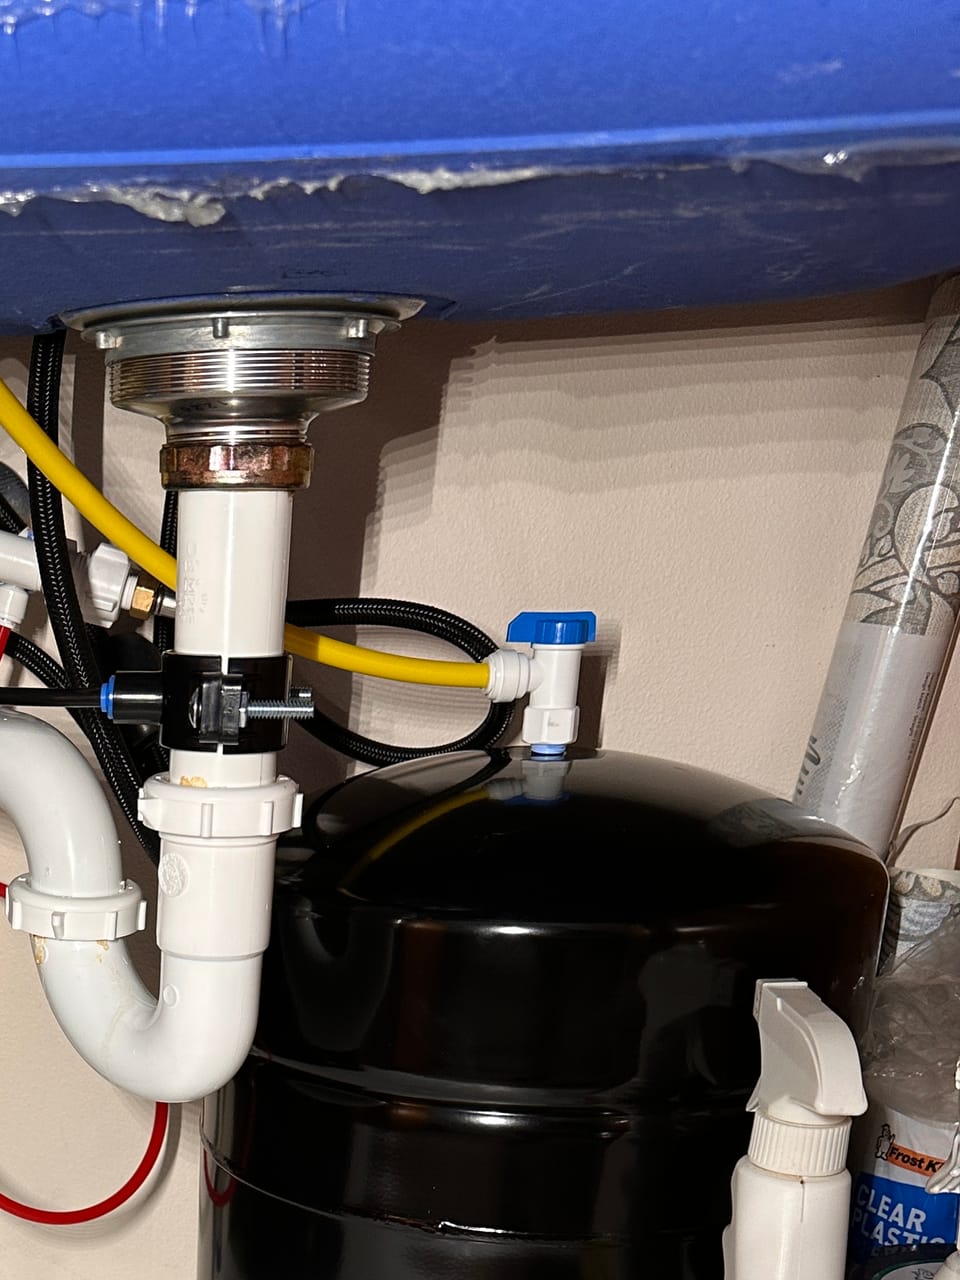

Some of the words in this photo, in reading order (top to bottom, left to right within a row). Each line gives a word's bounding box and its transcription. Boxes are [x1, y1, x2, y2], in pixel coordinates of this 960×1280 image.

[889, 1147, 924, 1170] Frost
[852, 1207, 946, 1247] PLAST
[858, 1184, 927, 1233] CLEAR
